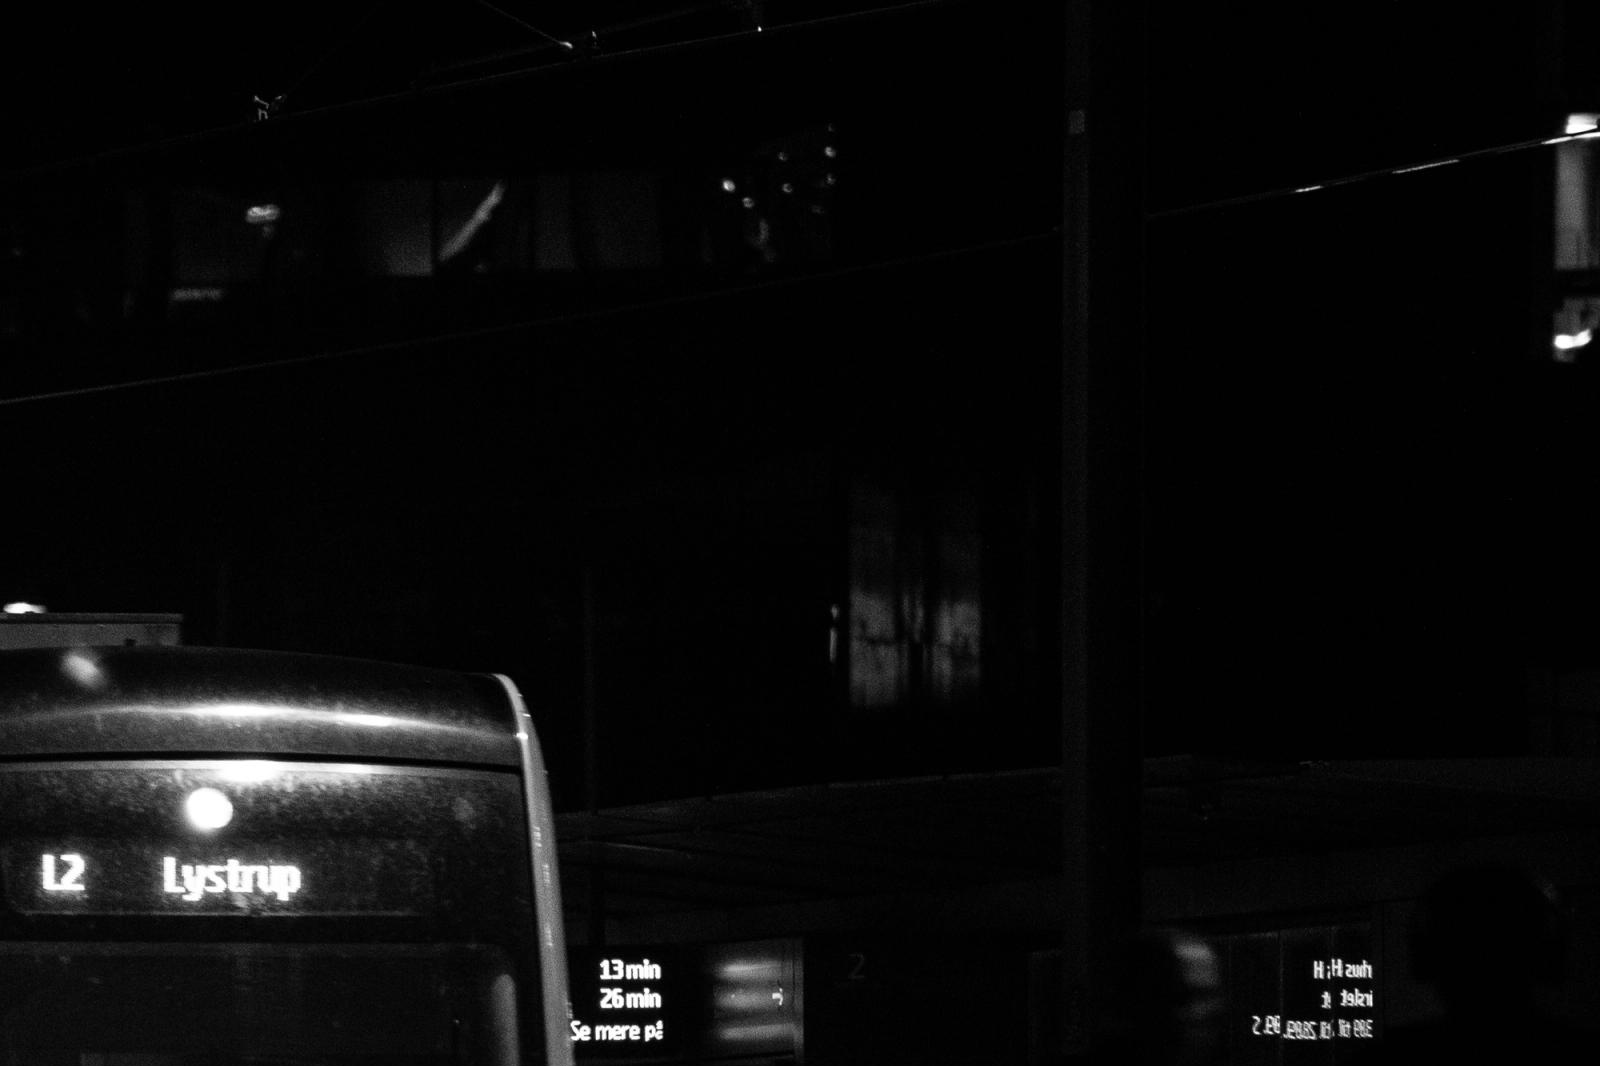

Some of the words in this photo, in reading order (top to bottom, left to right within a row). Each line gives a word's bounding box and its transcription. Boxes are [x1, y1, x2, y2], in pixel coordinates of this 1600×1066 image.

[41, 853, 86, 891] L2
[162, 856, 302, 901] Lystrup
[599, 958, 624, 980] 13
[625, 958, 662, 980] min
[847, 953, 866, 980] 2
[599, 987, 624, 1009] 26
[625, 987, 662, 1009] min
[570, 1020, 592, 1042] Se
[595, 1024, 641, 1041] mere
